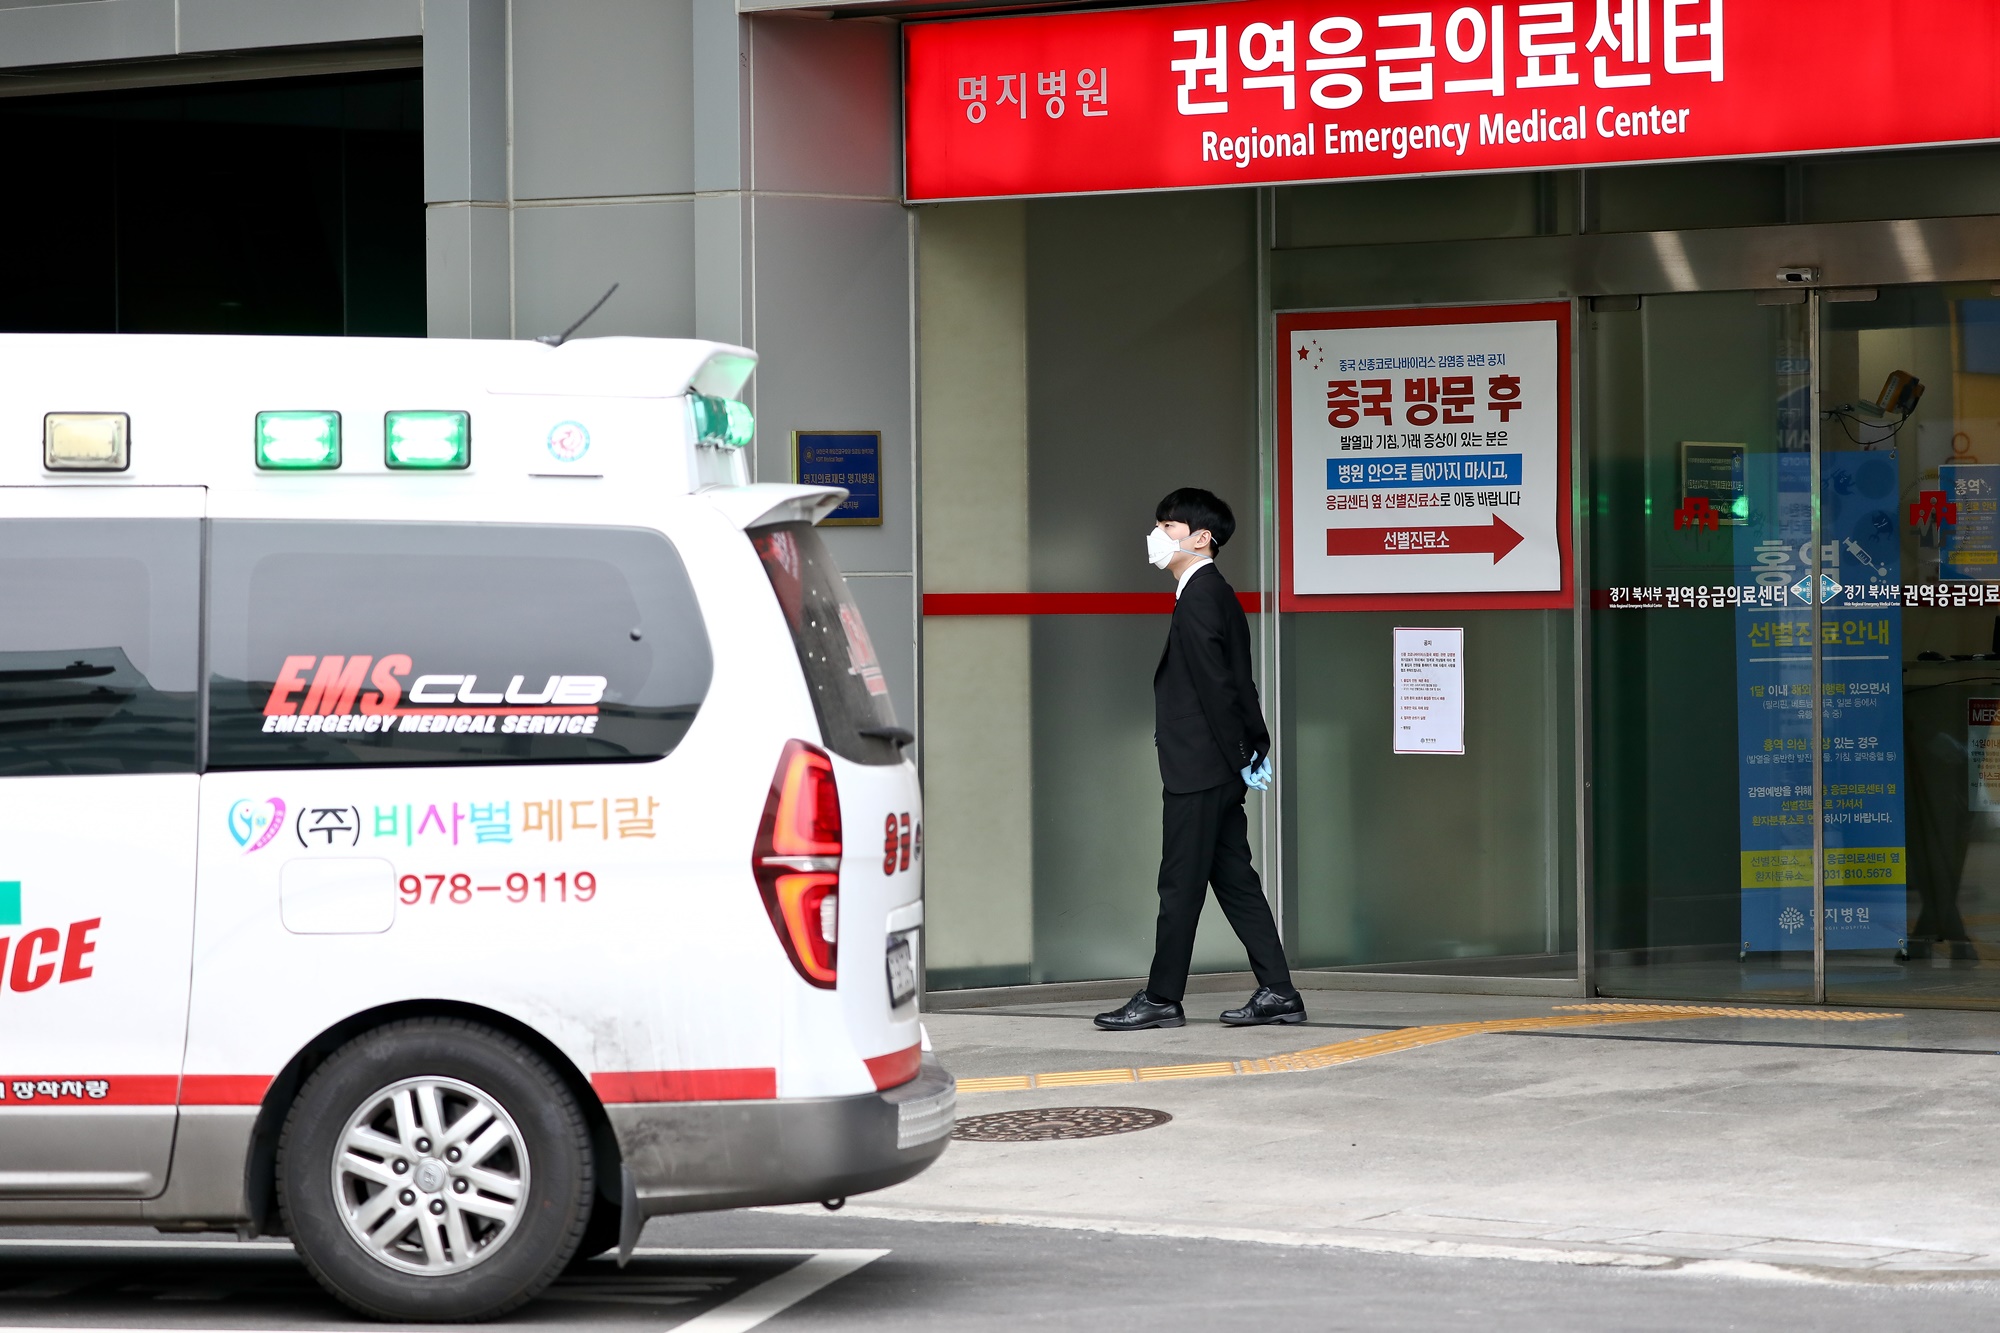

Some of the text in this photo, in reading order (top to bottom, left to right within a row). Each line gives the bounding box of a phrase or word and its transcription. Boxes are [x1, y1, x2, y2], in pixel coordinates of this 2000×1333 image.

[1170, 0, 1725, 116] 권역응급의료센터
[958, 67, 1109, 124] 명지병원
[1202, 104, 1690, 169] Regional Emergency Medical Center
[1339, 353, 1506, 372] 중국 신종코로나바이러스 감염증 관련 공지
[1326, 374, 1522, 429] 중국 방문 후
[1340, 434, 1373, 451] 발열과
[1401, 433, 1422, 449] 가래
[1423, 432, 1458, 449] 증상이
[1460, 431, 1483, 447] 있는
[1485, 430, 1508, 447] 분은
[803, 473, 875, 484] 명지의료재단 명지병원
[1338, 460, 1508, 484] 병원 안으로 들어가지 마시고,
[1955, 479, 1980, 496] 홍역
[1326, 490, 1521, 511] 응급센터 옆 선별진료소로 이동 바랍니다
[1383, 530, 1451, 550] 선별진료소
[1751, 540, 1840, 587] 홍역
[1609, 585, 1788, 608] 경기 북서부 권역응급의료센터
[1844, 583, 2000, 608] 경기 북서부 권역응급의료
[262, 653, 608, 716] EMS CLUB
[1750, 684, 1765, 697] 1달
[1768, 684, 1788, 697] 이내
[1849, 682, 1890, 695] 있으면서
[261, 714, 599, 734] EMERGENCY MEDICAL SERVICE
[1786, 738, 1807, 750] 의심
[1834, 736, 1854, 749] 있는
[1858, 736, 1878, 749] 경우
[1748, 785, 1792, 798] 감염예방을
[1794, 784, 1812, 797] 위해
[1831, 783, 1884, 796] 응급의료센터
[1886, 783, 1896, 795] 옆
[296, 804, 362, 849] (주)
[1854, 812, 1893, 825] 바랍니다.
[1827, 852, 1886, 865] 응급의료센터
[1890, 852, 1900, 865] 옆
[1823, 867, 1892, 880] 031.810.5678
[397, 870, 597, 906] 978-9119
[12, 1080, 109, 1099] 장착차량
